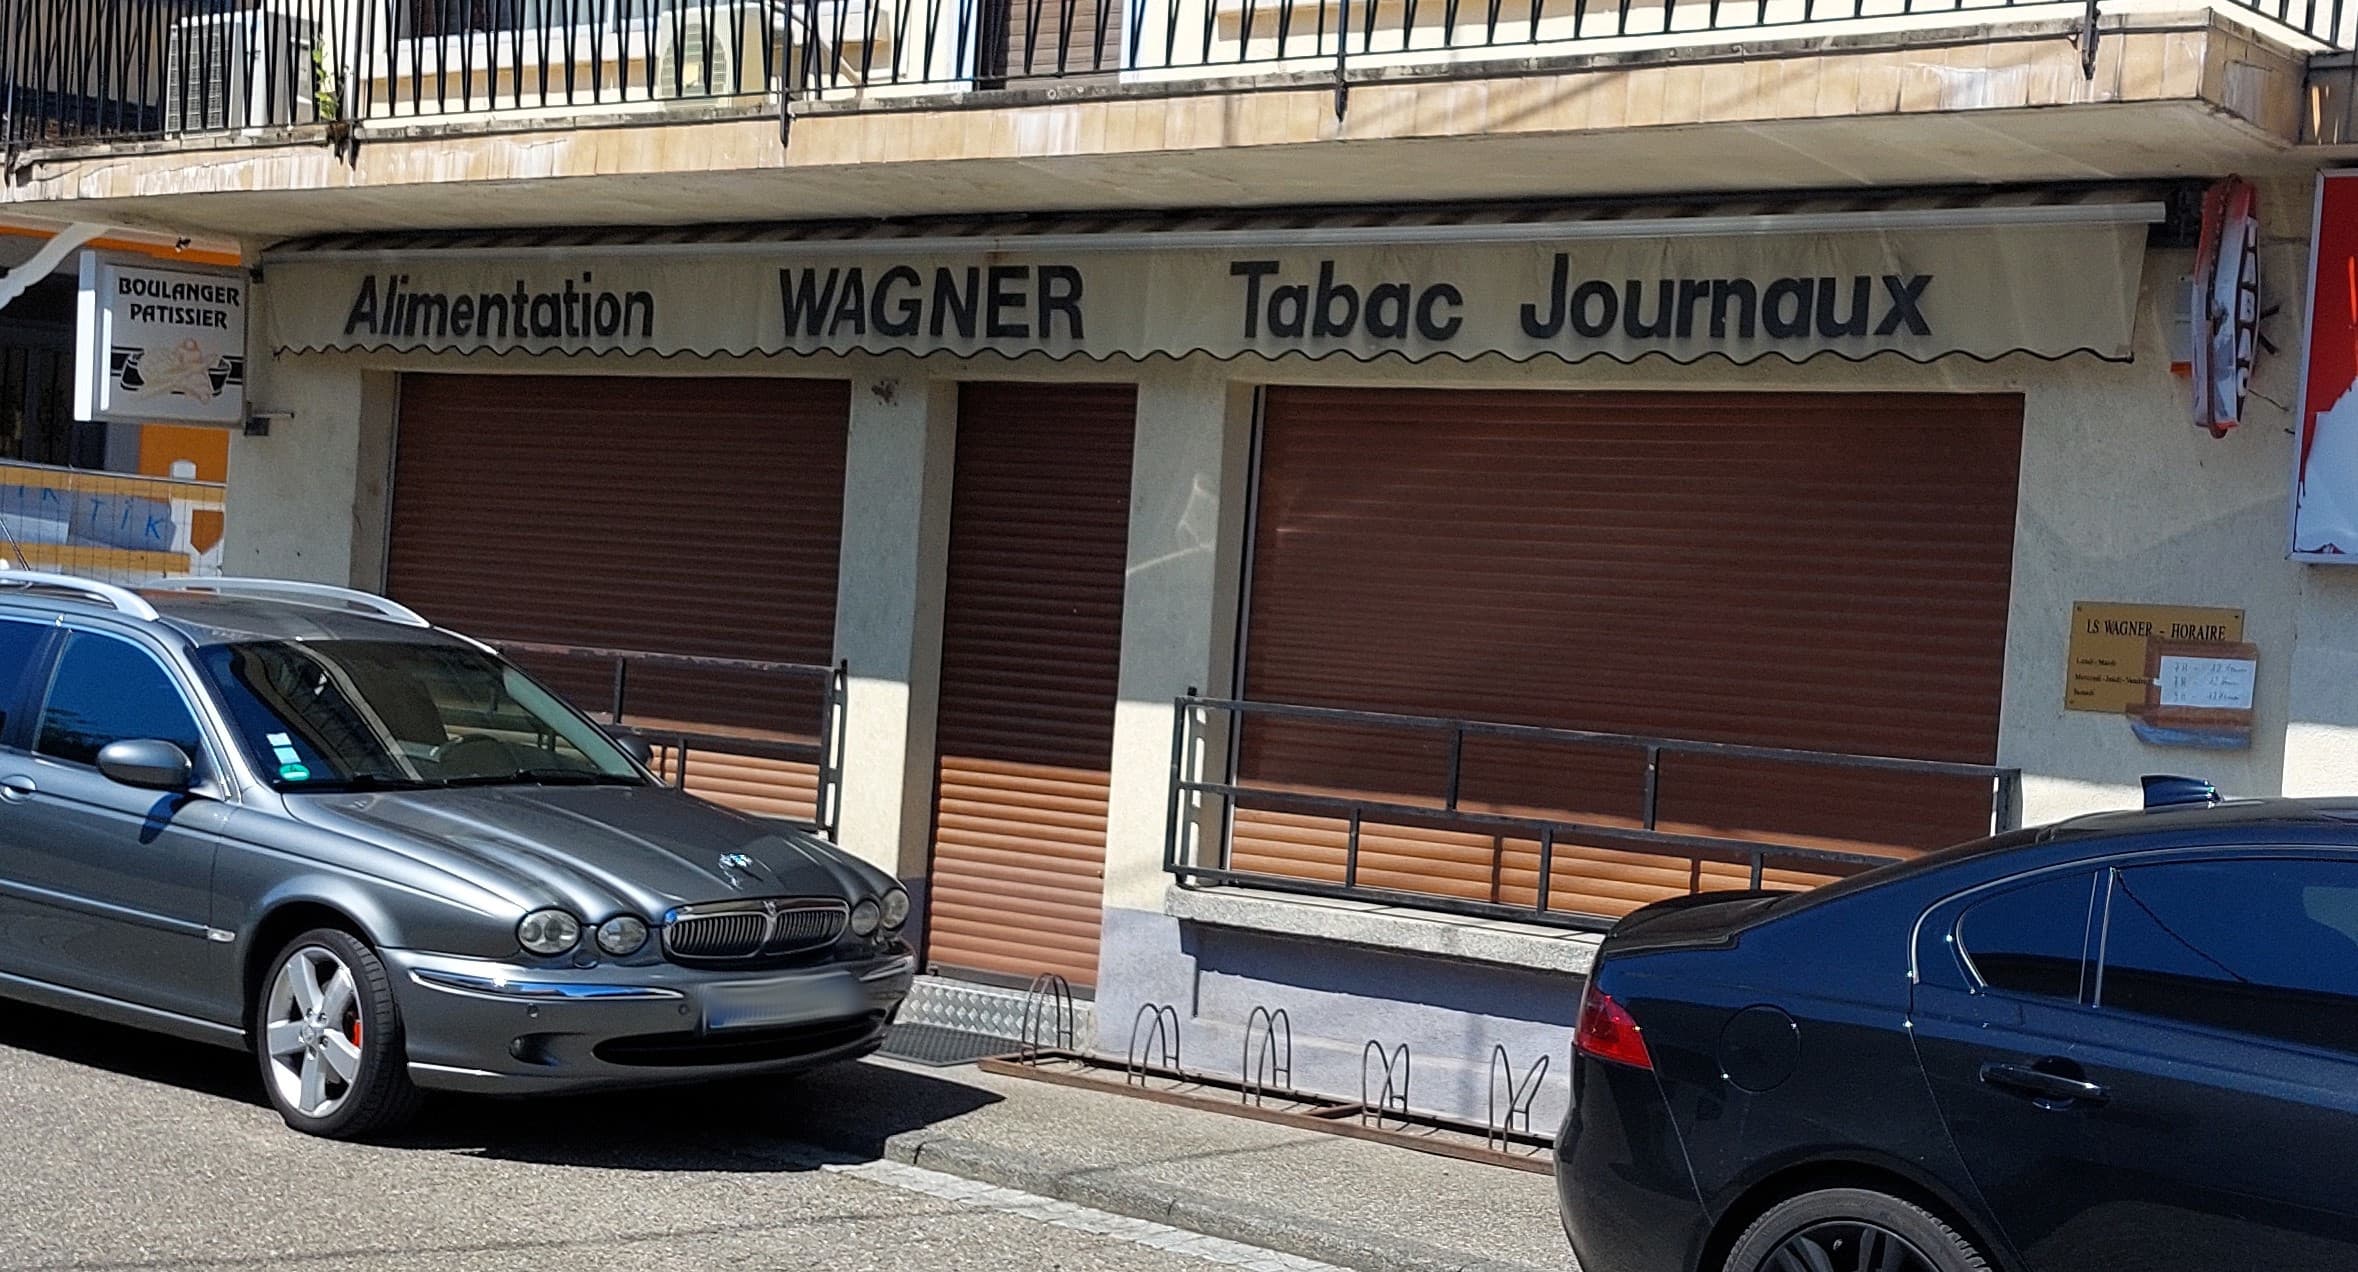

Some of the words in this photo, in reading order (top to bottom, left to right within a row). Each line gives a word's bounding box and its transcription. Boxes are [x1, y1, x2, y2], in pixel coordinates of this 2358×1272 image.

[118, 277, 240, 307] BOULANGER
[344, 270, 655, 338] Alimentation
[778, 264, 1085, 340] WAGNER
[1229, 260, 1464, 340] Tabac
[1519, 252, 1934, 339] Journaux
[129, 303, 228, 330] PATISSIER
[2087, 618, 2100, 634] LS
[2104, 619, 2153, 637] WAGNER
[2171, 623, 2226, 641] HORAIRE
